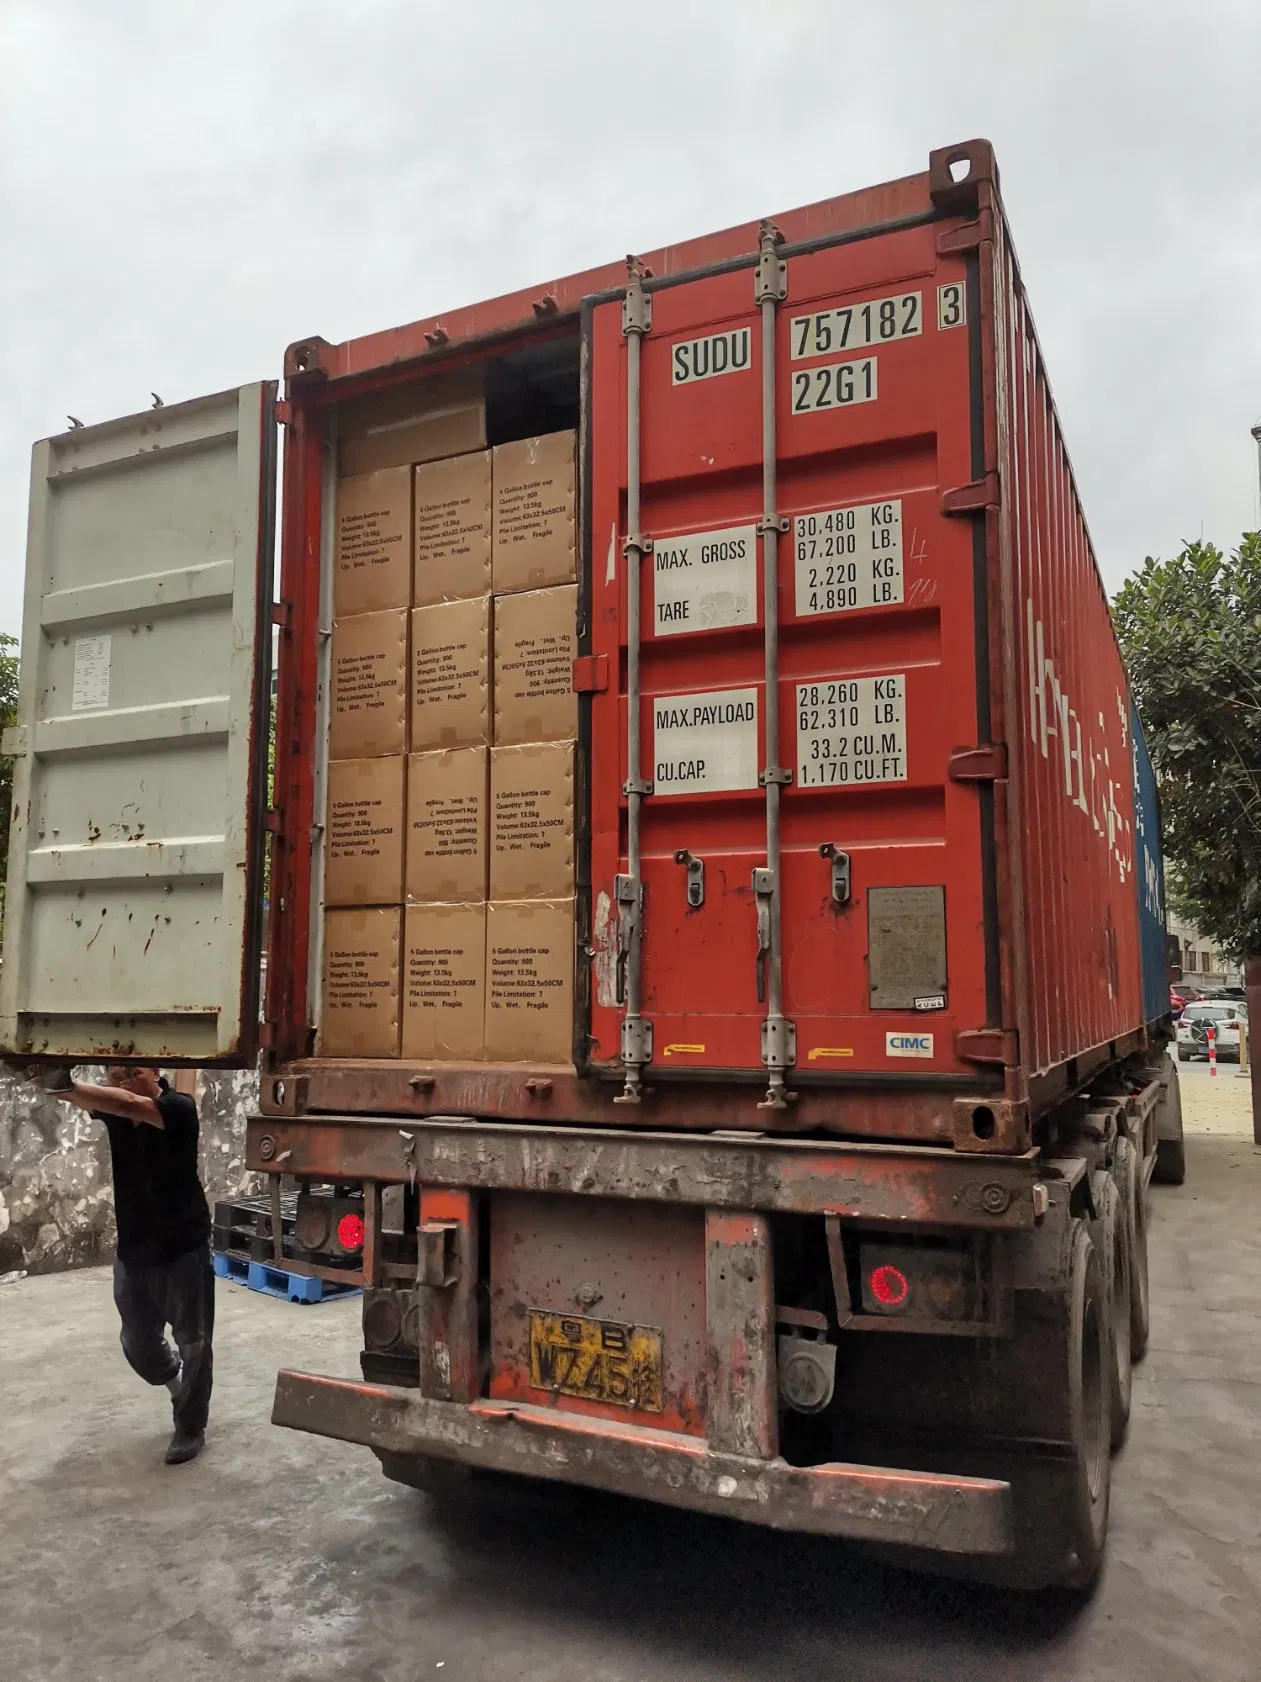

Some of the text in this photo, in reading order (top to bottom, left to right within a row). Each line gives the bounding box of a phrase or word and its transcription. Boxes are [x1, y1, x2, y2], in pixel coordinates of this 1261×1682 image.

[674, 286, 960, 381] SUDU 757182 3
[795, 361, 872, 411] 22G1
[797, 504, 899, 538] 30,480 KG.
[656, 539, 746, 571] MAX. GROSS
[797, 528, 897, 561] 67,200 LB.
[809, 557, 900, 588] 2,220 KG.
[809, 586, 857, 611] 4,890
[873, 582, 898, 603] LB.
[657, 600, 690, 622] TARE
[515, 640, 535, 648] Fragile
[545, 687, 565, 695] Gallon
[799, 679, 902, 707] 28,260 KG.
[656, 702, 754, 729] MAX.PAYLOAD
[799, 703, 900, 731] 62,310 LB.
[811, 733, 902, 759] 33.2 CU.M.
[657, 760, 706, 782] CU.CAP.
[801, 757, 904, 784] 1,170 CU.FT.
[527, 1001, 548, 1010] Fragile
[890, 1037, 930, 1050] CIMC
